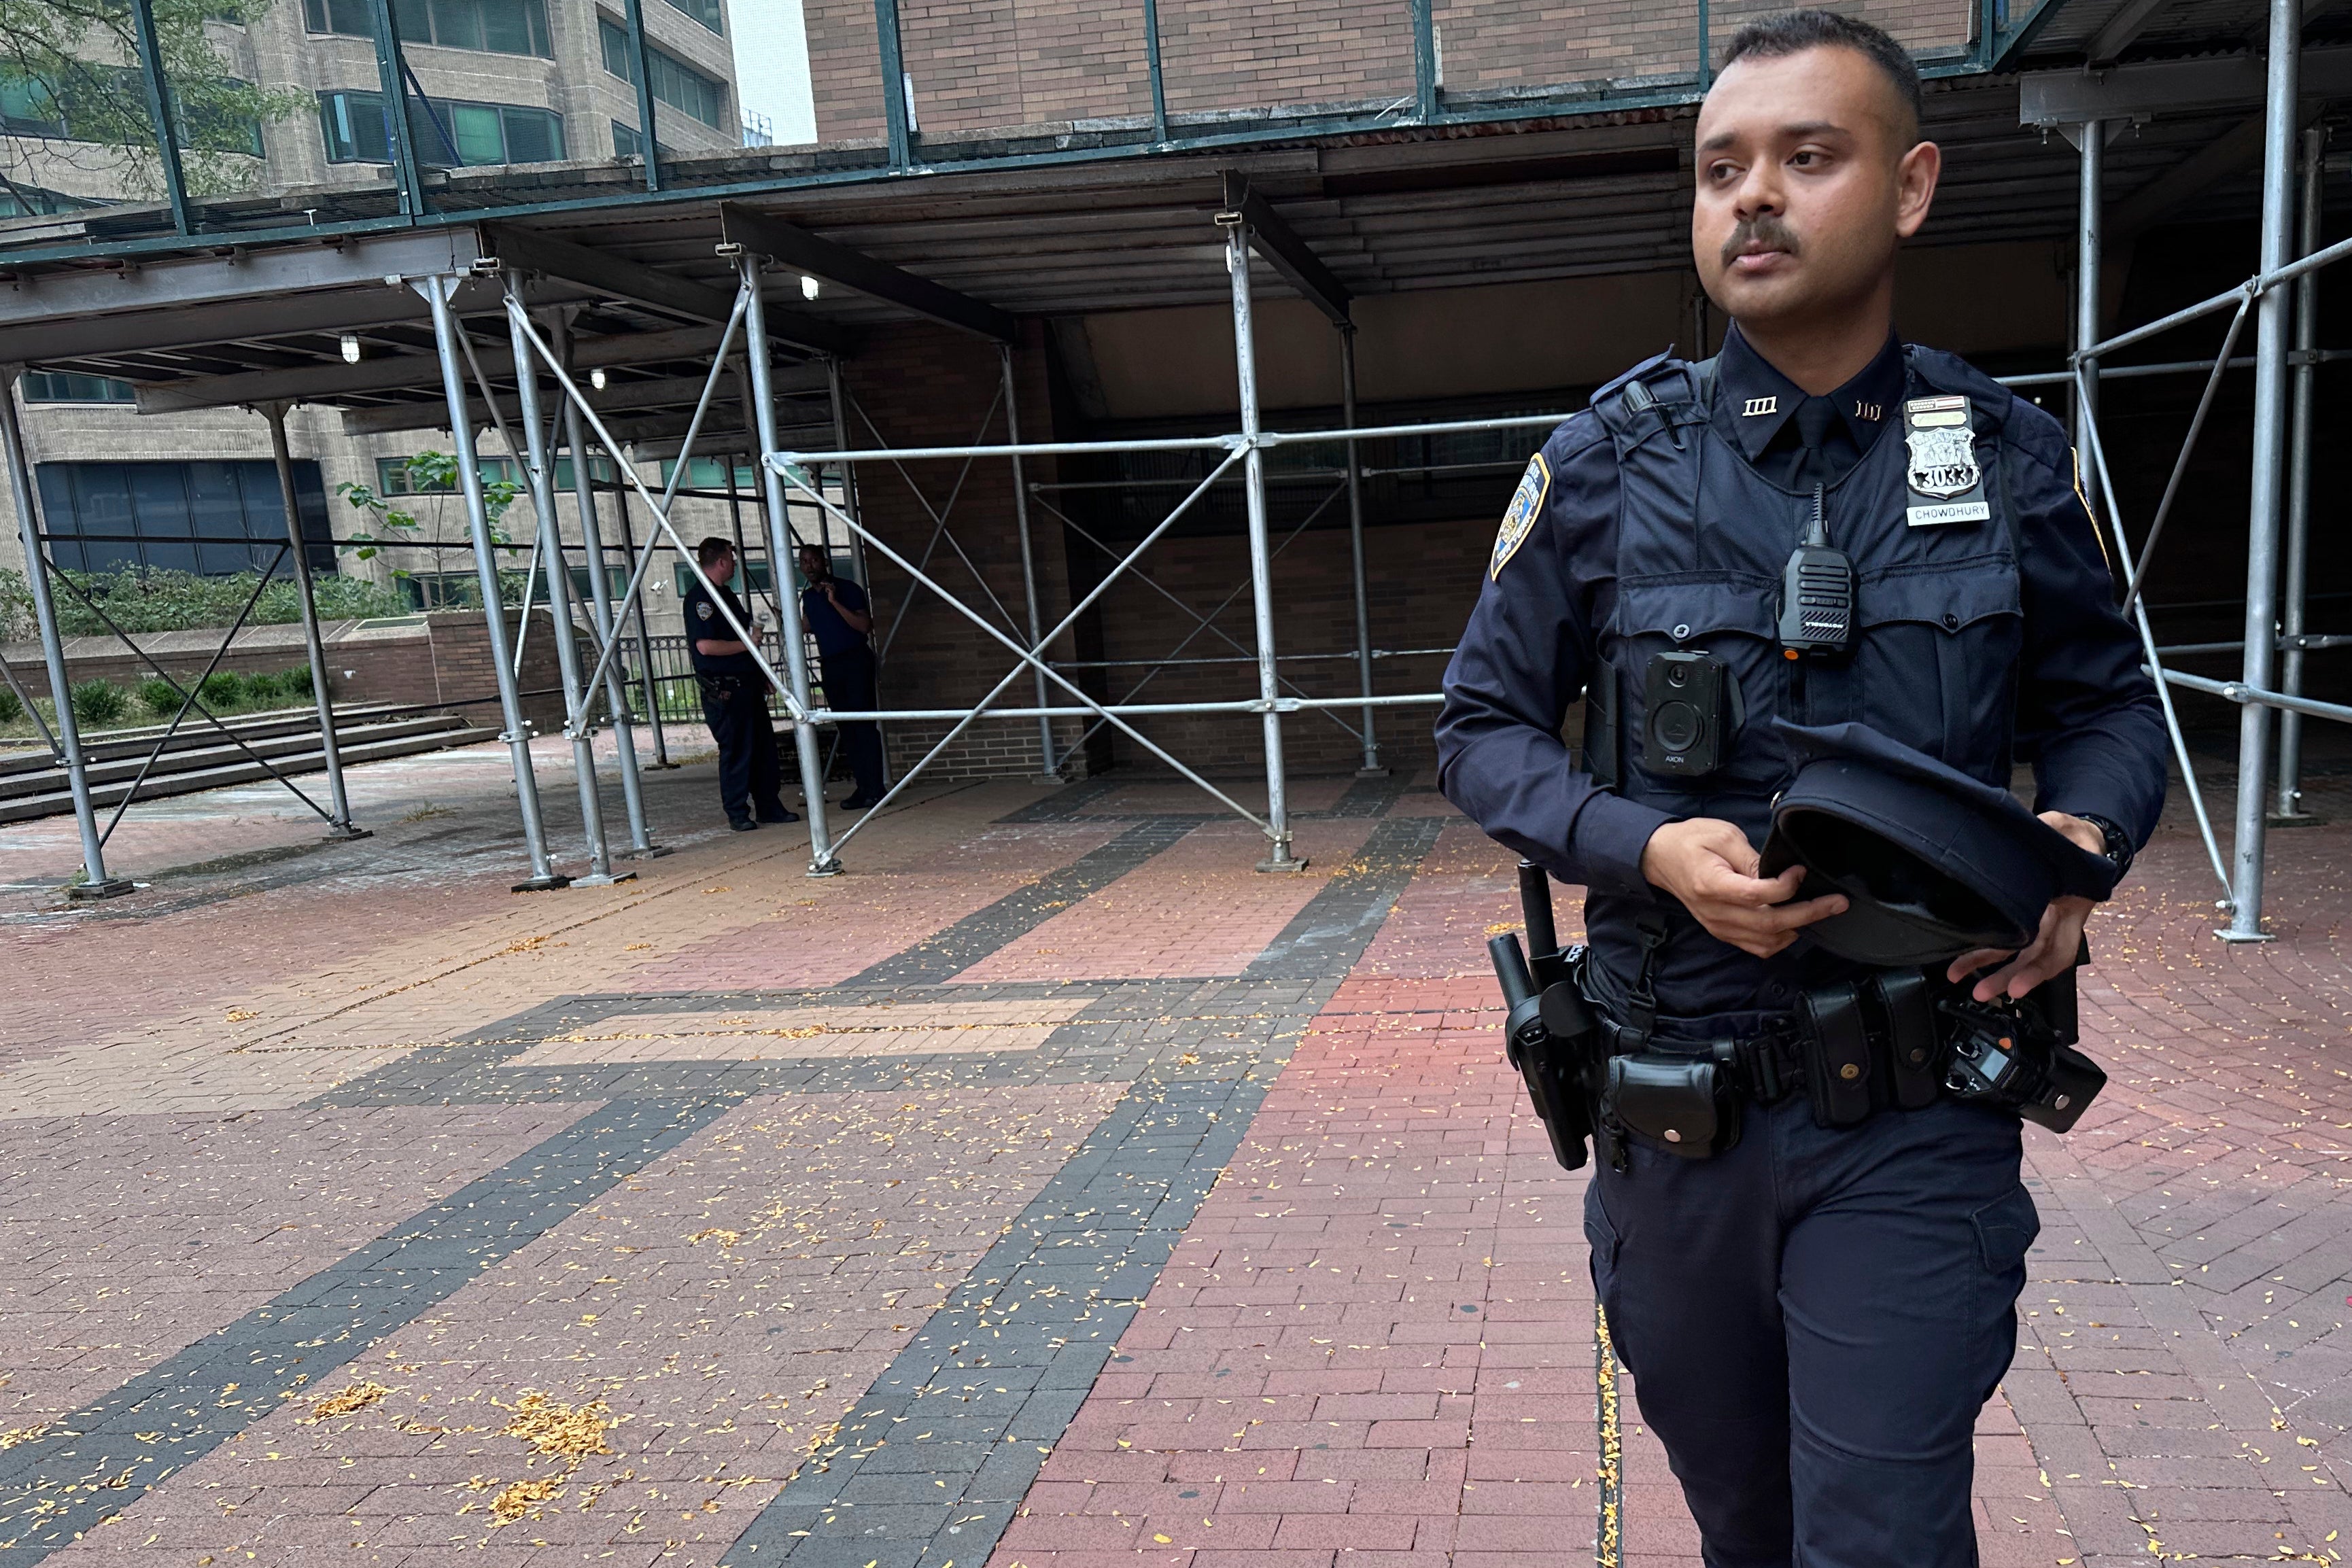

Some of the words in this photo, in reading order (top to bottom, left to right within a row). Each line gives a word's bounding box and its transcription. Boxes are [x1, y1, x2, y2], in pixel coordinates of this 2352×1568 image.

[1922, 464, 1968, 489] 3033
[1915, 505, 1986, 520] CHOWDHURY
[1665, 755, 1684, 763] AXON
